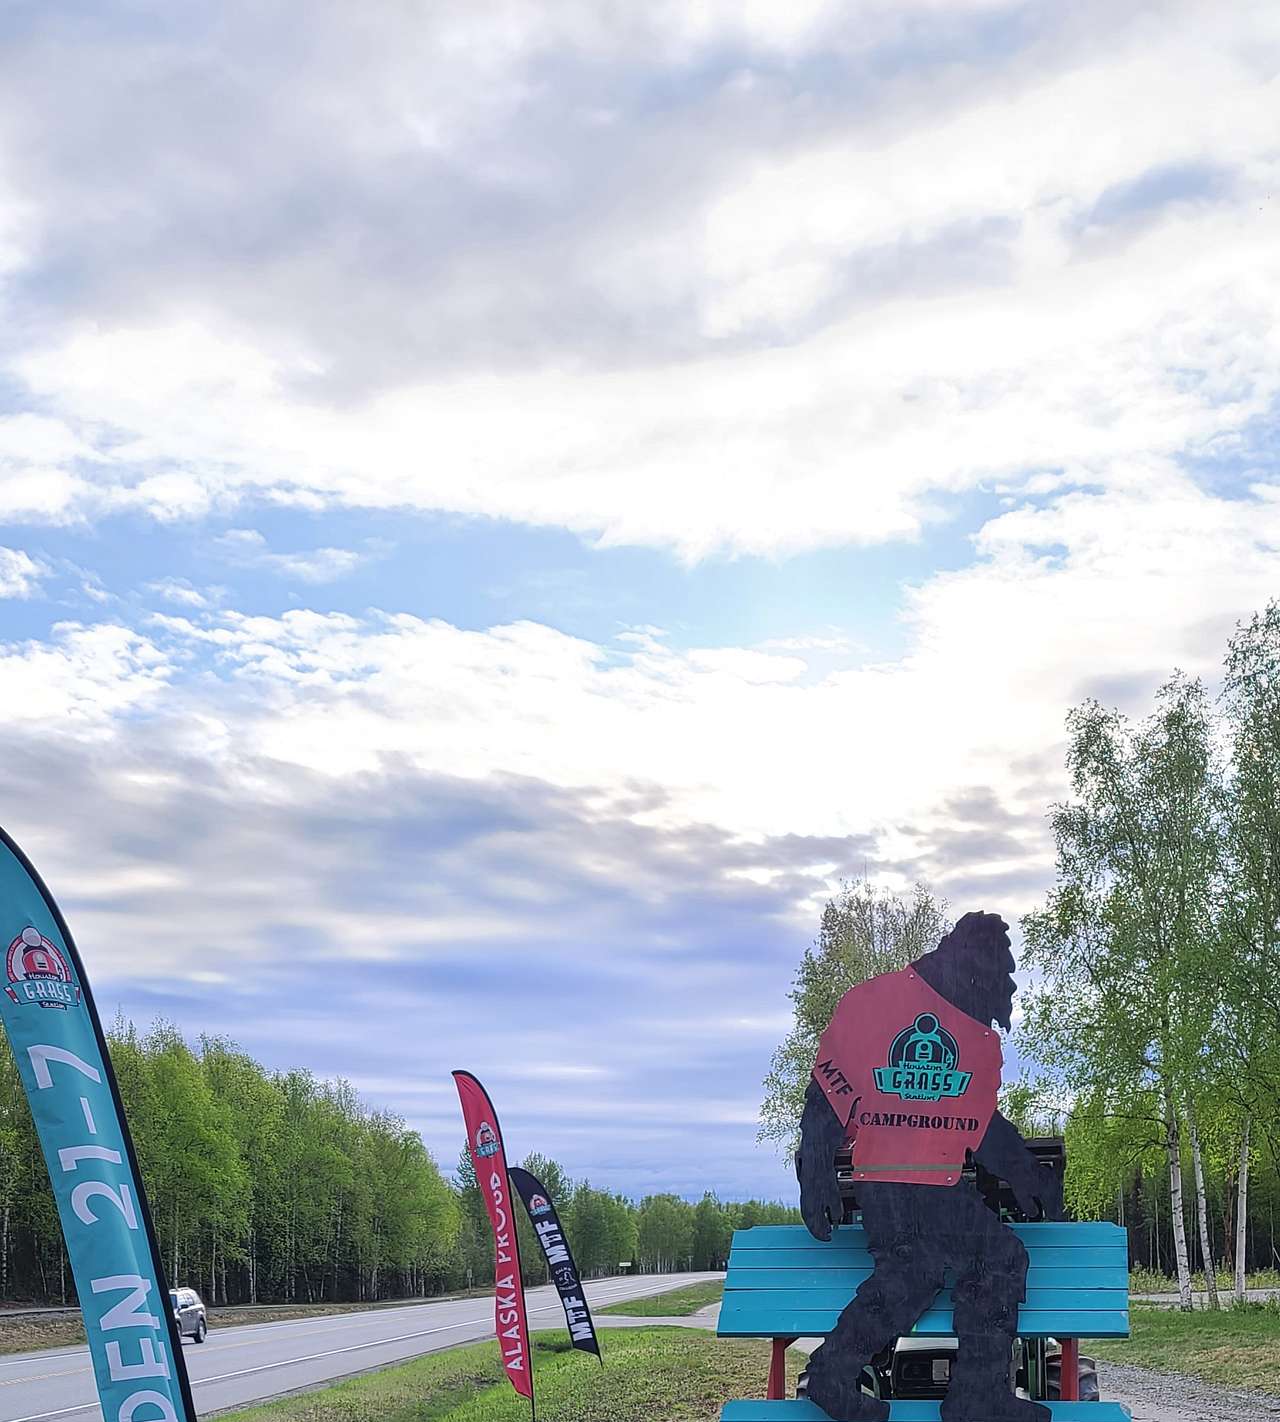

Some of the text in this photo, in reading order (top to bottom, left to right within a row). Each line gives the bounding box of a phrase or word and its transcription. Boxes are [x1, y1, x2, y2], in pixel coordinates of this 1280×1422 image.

[23, 982, 72, 1002] GRASS
[818, 1059, 853, 1095] MTF
[892, 1071, 953, 1092] GRASS
[903, 1063, 944, 1071] Houston
[27, 1044, 139, 1230] 21-7
[860, 1111, 979, 1132] CAMPGROUND
[535, 1220, 570, 1265] MTF
[497, 1274, 524, 1371] ALASKA
[564, 1296, 593, 1342] MTF
